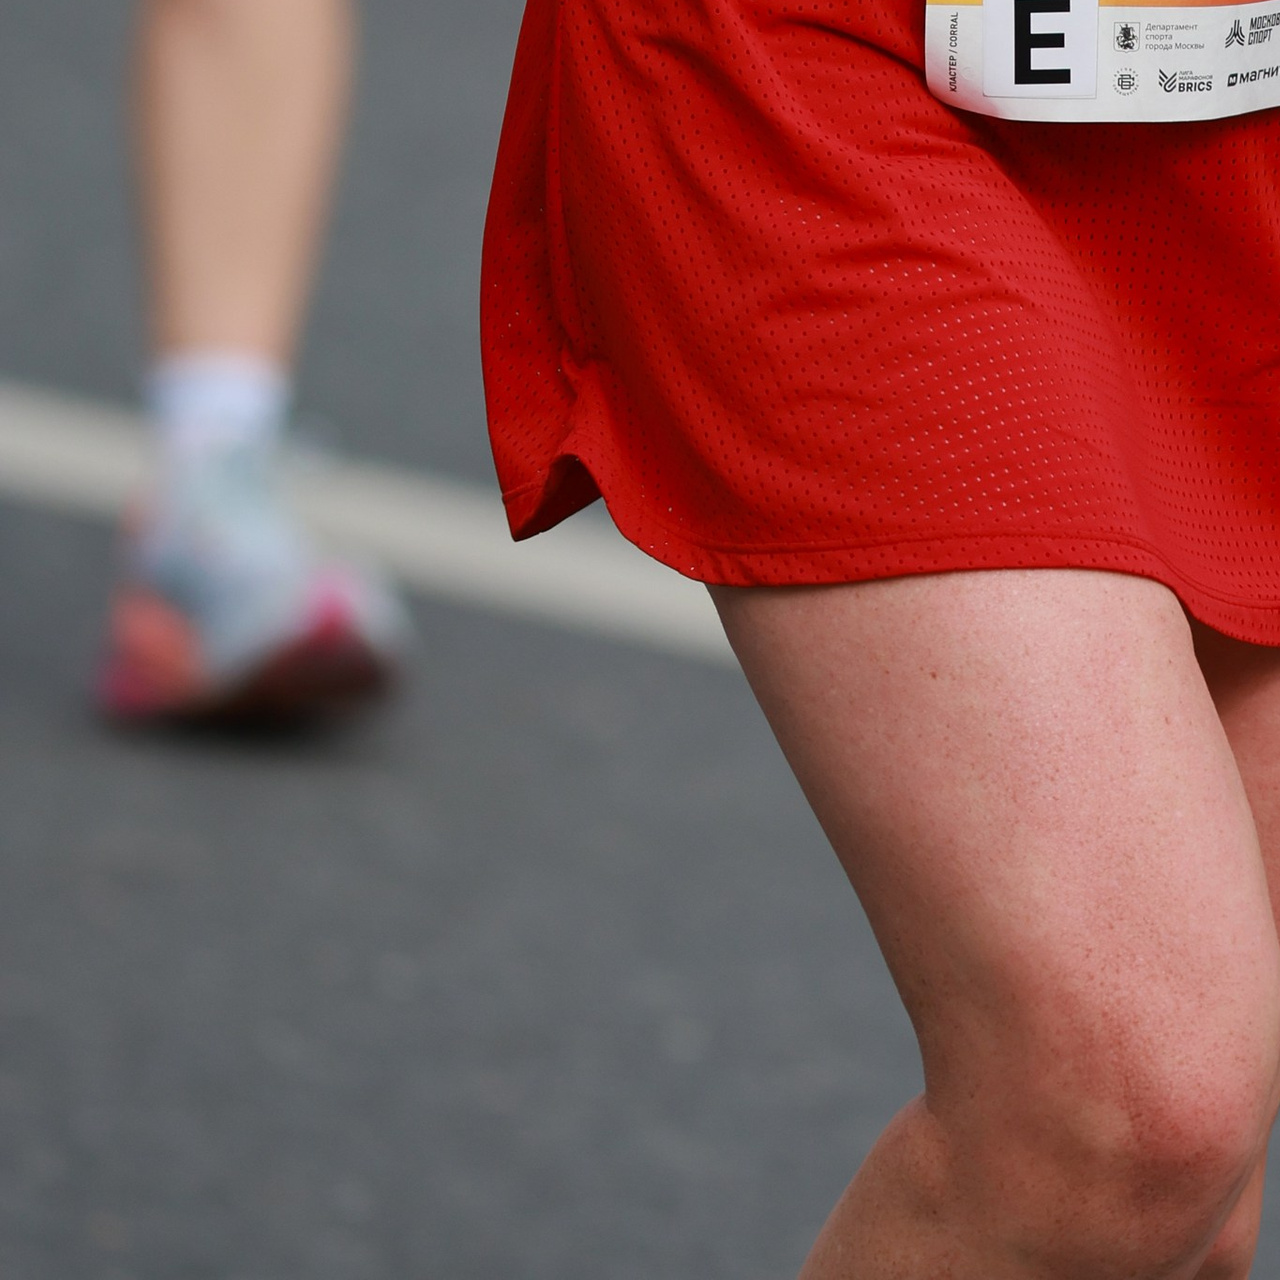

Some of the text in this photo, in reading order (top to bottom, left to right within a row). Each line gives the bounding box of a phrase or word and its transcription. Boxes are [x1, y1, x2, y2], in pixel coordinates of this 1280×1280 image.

[949, 12, 958, 48] CORRAL
[1145, 23, 1198, 32] Департамент
[1145, 34, 1173, 42] спорта
[1248, 28, 1273, 46] СПОРТ
[1145, 42, 1205, 51] города Москвы
[1178, 81, 1213, 93] BRICS
